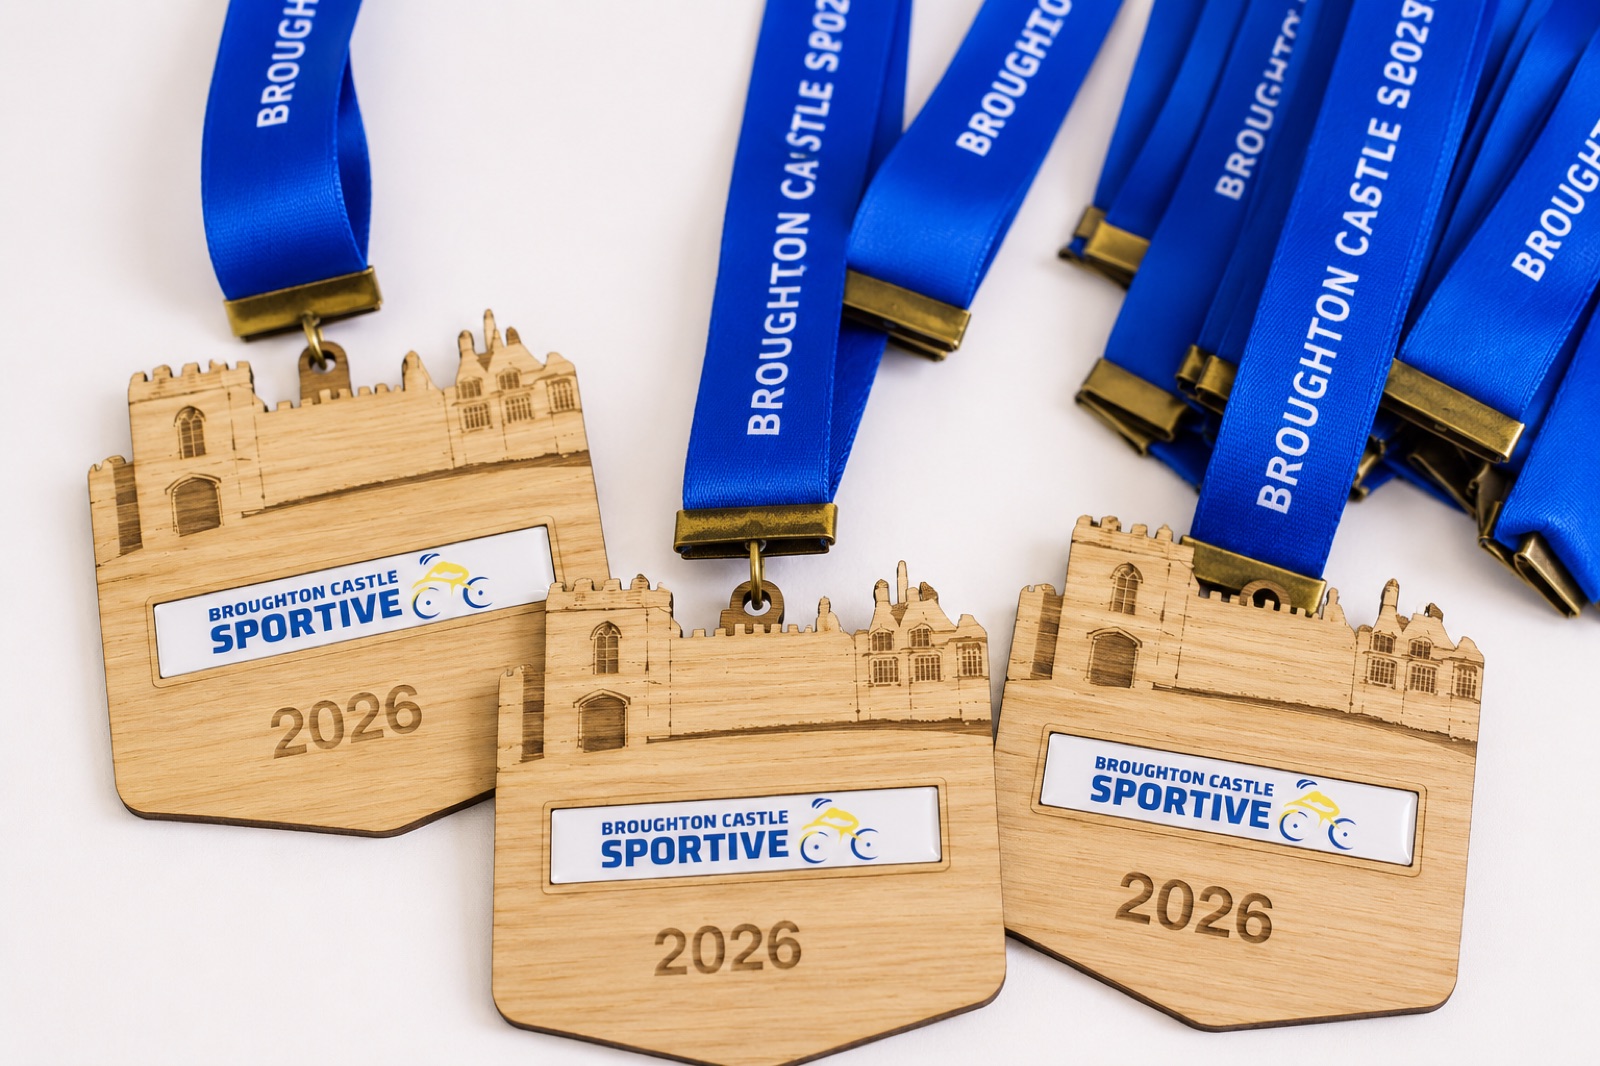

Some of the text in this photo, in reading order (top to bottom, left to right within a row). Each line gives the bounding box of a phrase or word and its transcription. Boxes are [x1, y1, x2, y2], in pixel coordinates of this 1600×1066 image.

[747, 212, 810, 436] BROUGHTON
[1256, 265, 1360, 514] BROUGHTON
[1334, 118, 1402, 256] CASTLE
[209, 570, 398, 622] BROUGHTON CASTLE
[211, 589, 402, 654] SPORTIVE
[271, 685, 423, 759] 2026
[1091, 775, 1272, 829] SPORTIVE
[1095, 756, 1275, 797] BROUGHTON CASTLE
[602, 810, 788, 835] BROUGHTON CASTLE
[602, 829, 789, 868] SPORTIVE
[1115, 872, 1273, 943] 2026
[654, 920, 802, 976] 2026
